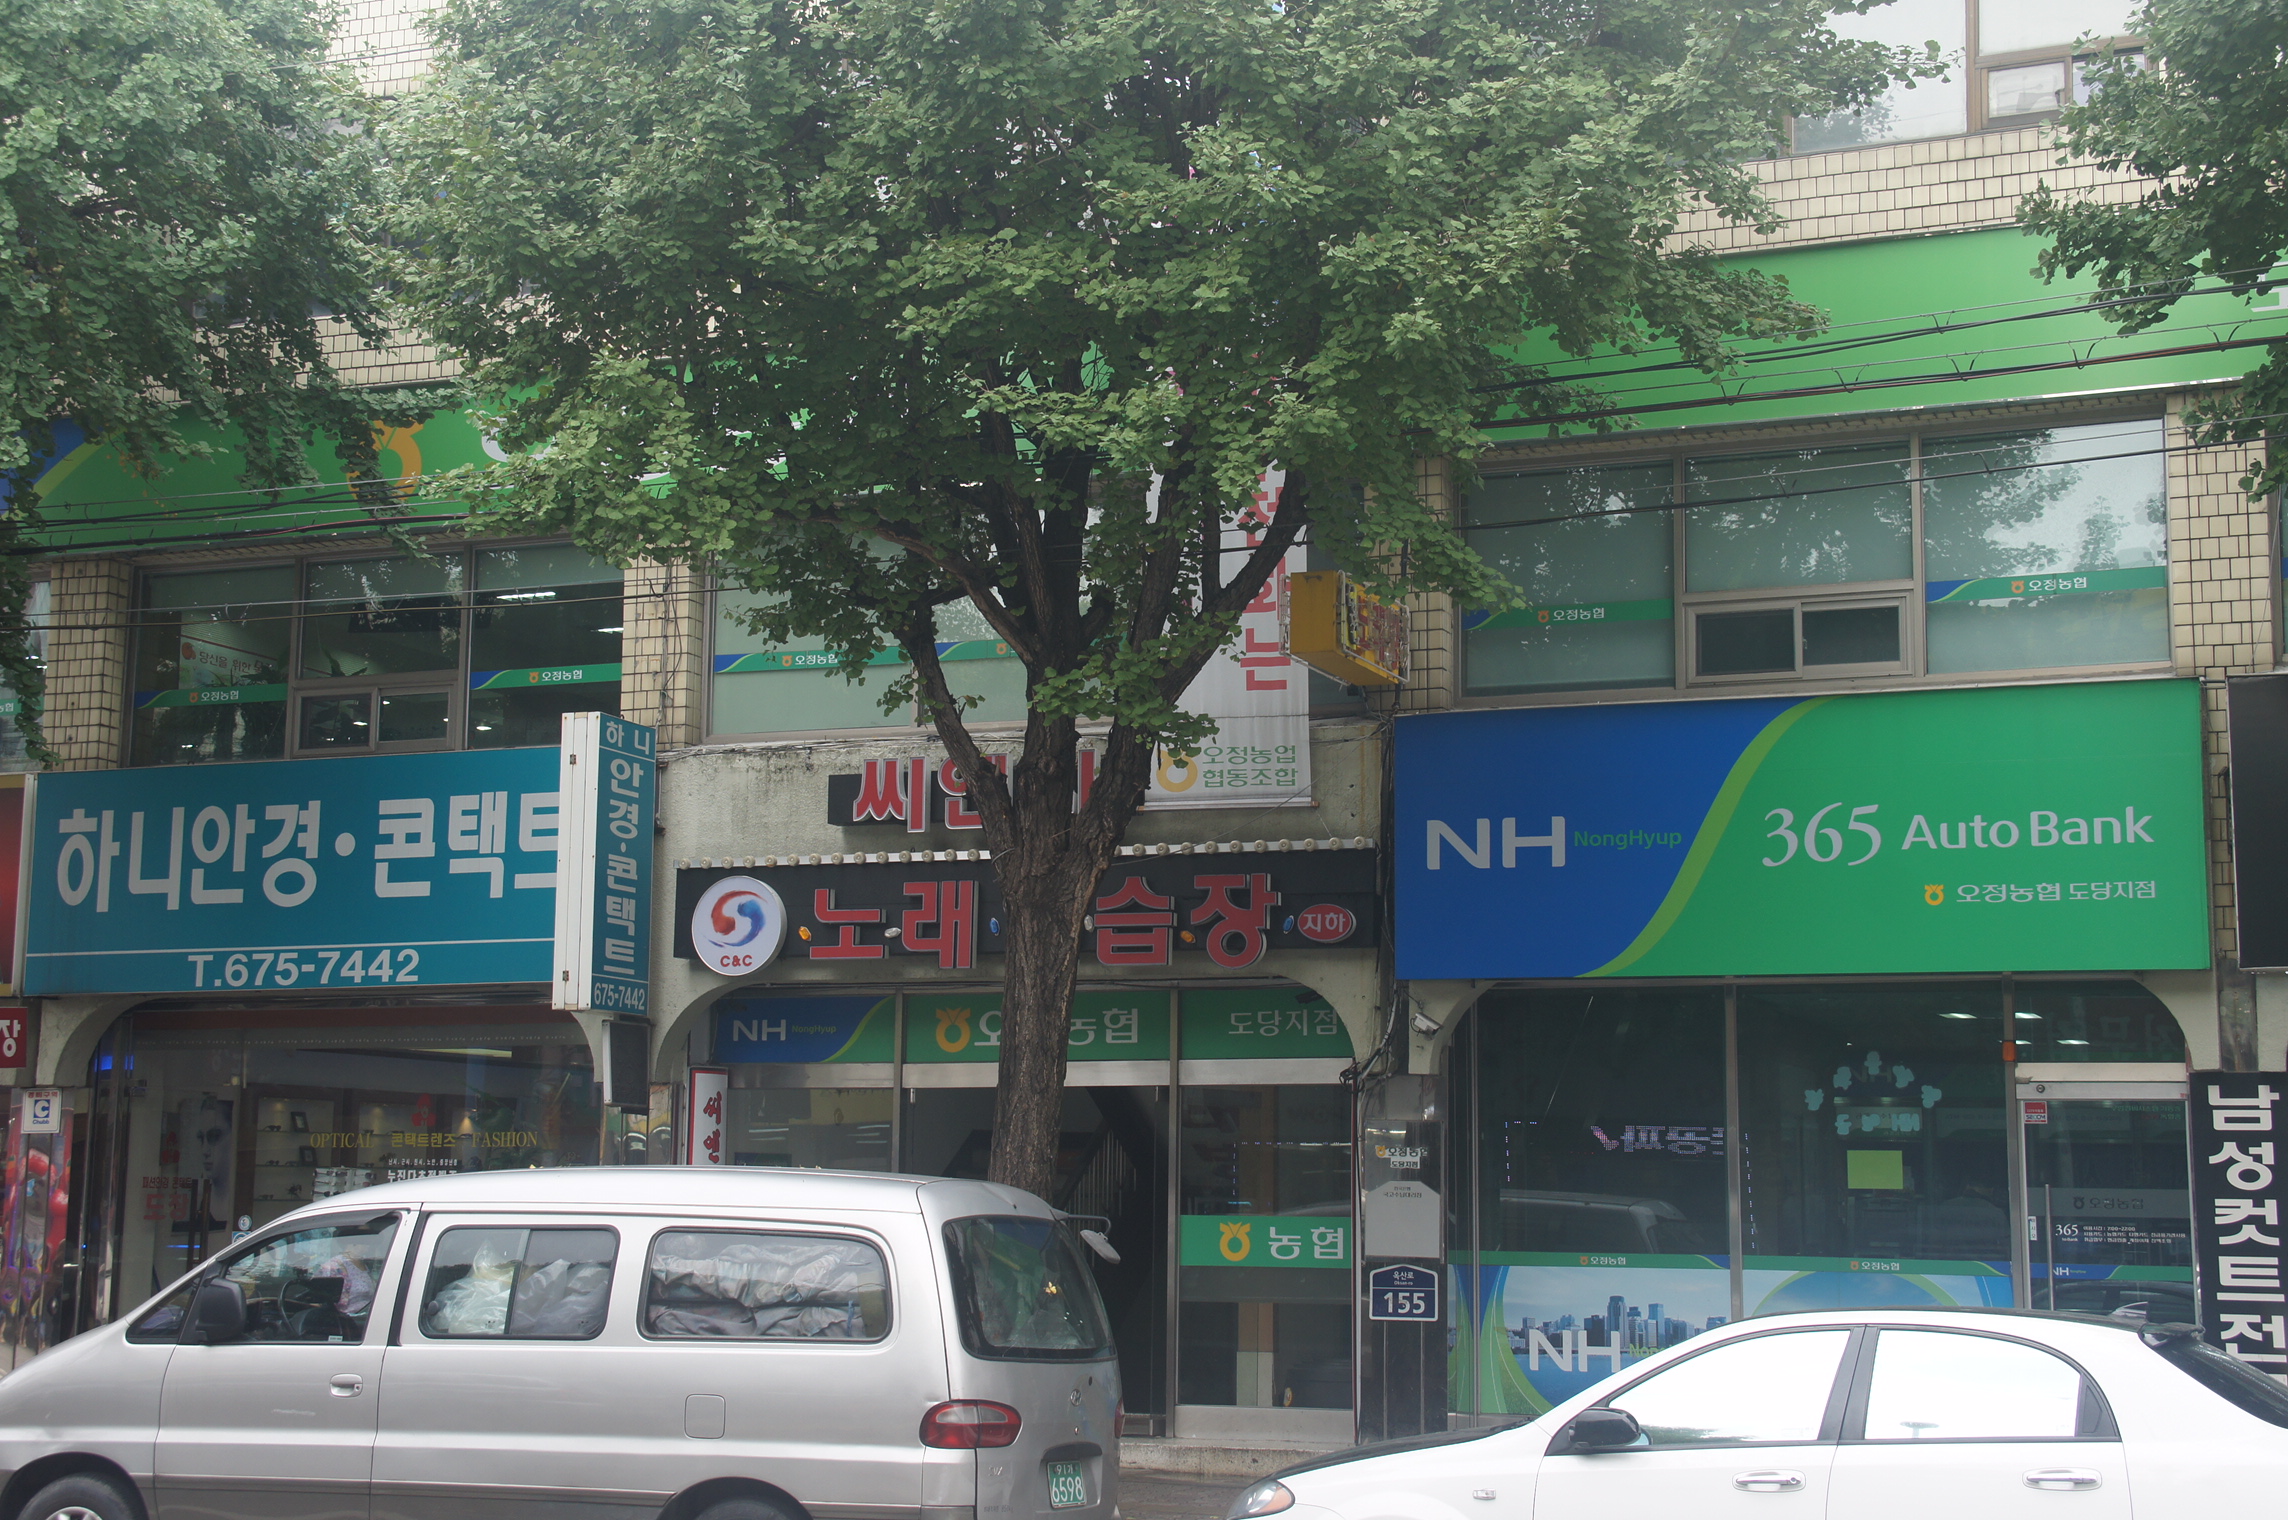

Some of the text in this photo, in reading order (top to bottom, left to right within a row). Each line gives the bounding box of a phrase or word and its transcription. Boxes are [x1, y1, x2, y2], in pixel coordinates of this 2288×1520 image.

[2028, 577, 2087, 591] 오정농협
[1553, 607, 1605, 621] 오정농협
[794, 653, 838, 666] 오정농협
[541, 669, 583, 682] 오정농협
[200, 690, 240, 702] 오정농협
[606, 721, 650, 755] 하니
[1202, 745, 1296, 765] 오정농업
[1202, 768, 1299, 788] 협동조합
[1426, 816, 1683, 870] NH NongHyup
[1762, 802, 2155, 867] 365 Auto Bank
[1956, 881, 2157, 903] 오정농협 도당지점
[809, 873, 1282, 969] 노래습장
[1302, 912, 1346, 933] 지하
[188, 948, 419, 988] T.675-7442
[720, 954, 753, 967] C&C
[593, 982, 645, 1011] 675-7442
[732, 1019, 837, 1042] NH NongHyup
[974, 1008, 1138, 1046] 오농협
[1228, 1009, 1338, 1037] 도당지점
[310, 1131, 539, 1148] OPTICAL 콘택트렌즈 FASHION
[2089, 1197, 2144, 1209] 오정농협
[2055, 1223, 2079, 1236] 365
[2207, 1085, 2288, 1388] 남성컷트전
[1268, 1226, 1344, 1260] 농협
[1590, 1256, 1626, 1266] 오정농협
[1861, 1261, 1900, 1271] 오정농협
[1393, 1271, 1414, 1280] 옥산로
[1383, 1292, 1426, 1314] 155
[1529, 1329, 1621, 1373] NH
[1052, 1476, 1084, 1503] 6598
